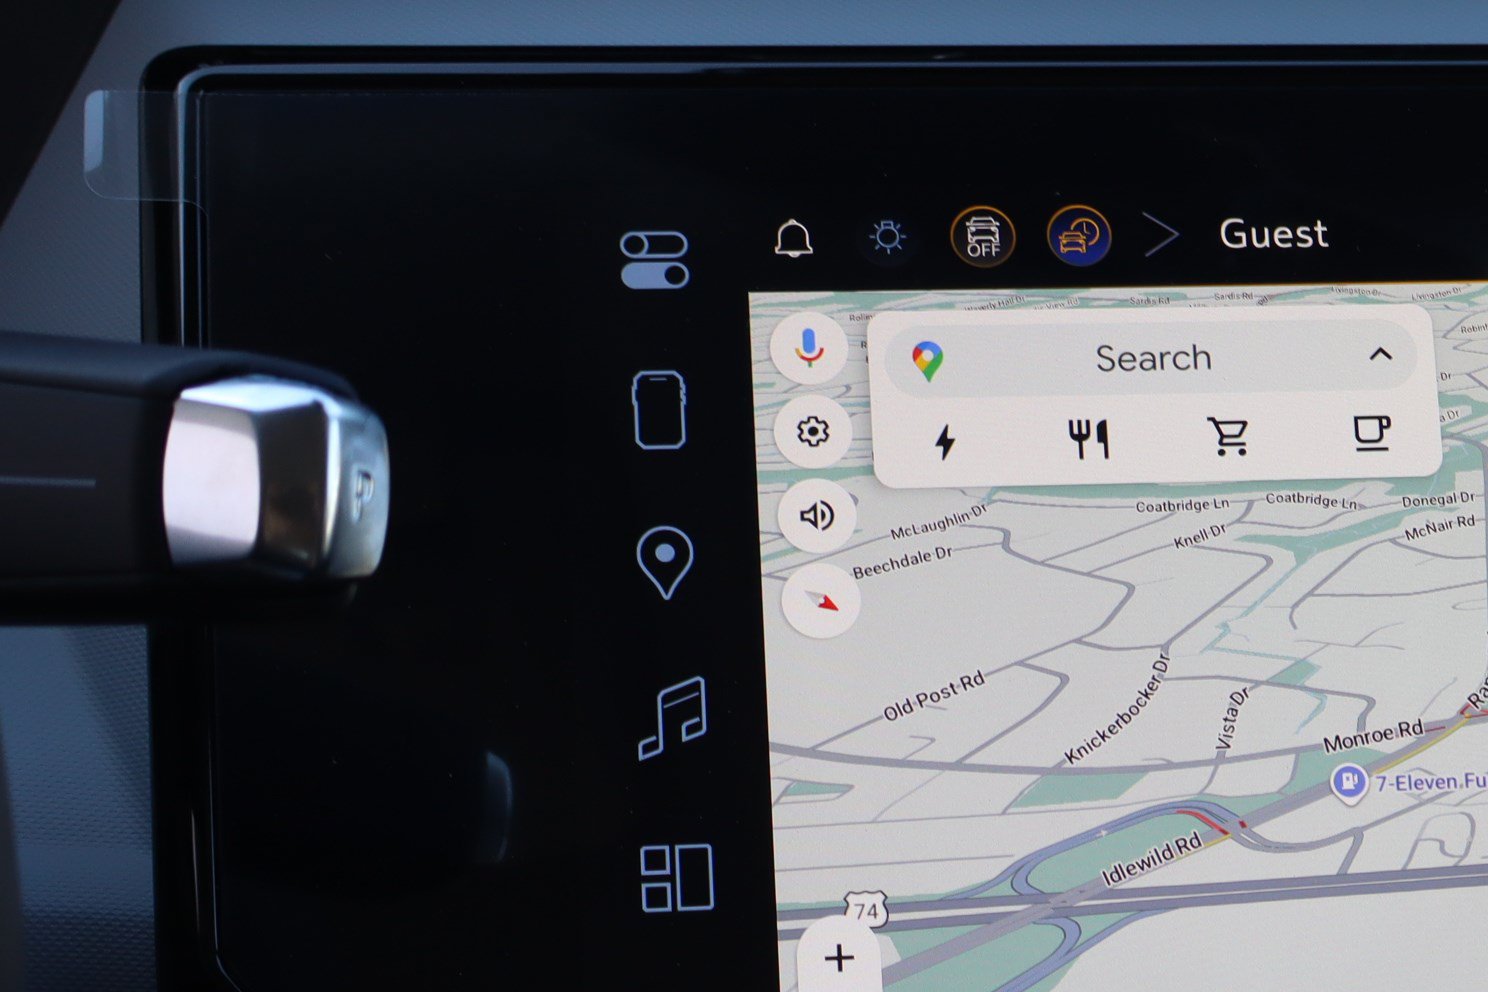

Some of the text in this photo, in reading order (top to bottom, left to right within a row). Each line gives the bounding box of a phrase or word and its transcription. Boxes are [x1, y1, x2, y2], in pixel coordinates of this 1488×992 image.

[1219, 218, 1330, 250] Guest
[967, 242, 1000, 259] OFF
[1096, 343, 1213, 373] Search
[1136, 498, 1230, 514] Coatbridge Ln
[1265, 493, 1358, 511] Coatbridge Ln
[1402, 491, 1476, 510] Donegal Dr
[890, 503, 988, 540] McLaughlin Dr
[1174, 522, 1227, 549] Knell Dr
[1404, 515, 1476, 542] McNair Rd
[853, 546, 952, 580] Beechdale Dr
[883, 670, 986, 722] Old Post Rd
[1063, 652, 1171, 766] Knickerbocker Dr
[1215, 686, 1251, 752] Vista Dr
[1323, 718, 1425, 754] Monroe Rd
[1376, 773, 1457, 793] 7-Eleven
[1101, 832, 1203, 888] Idlewild Rd
[854, 903, 879, 920] 74
